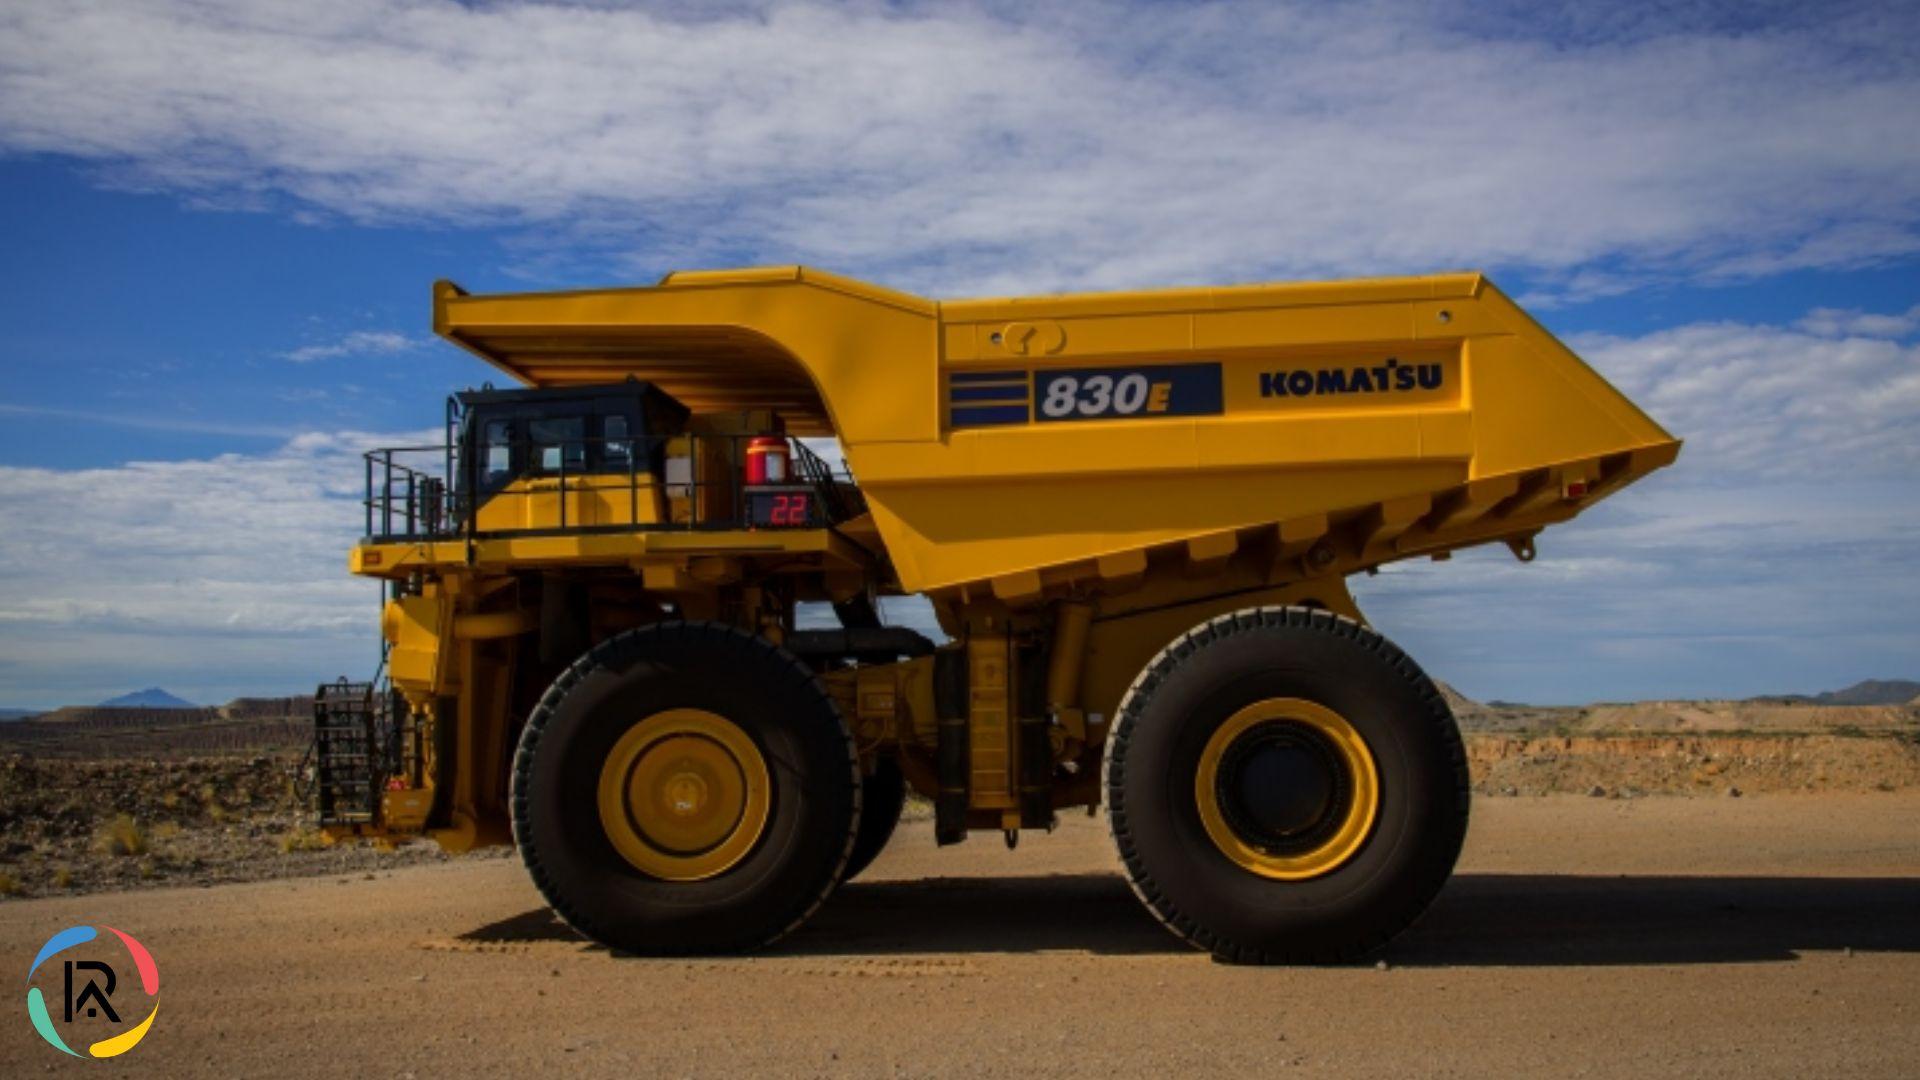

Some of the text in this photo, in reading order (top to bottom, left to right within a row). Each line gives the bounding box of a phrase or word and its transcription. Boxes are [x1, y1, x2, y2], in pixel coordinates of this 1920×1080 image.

[1042, 375, 1172, 417] 830E
[1260, 360, 1443, 397] KOMATSU
[770, 494, 808, 525] 22
